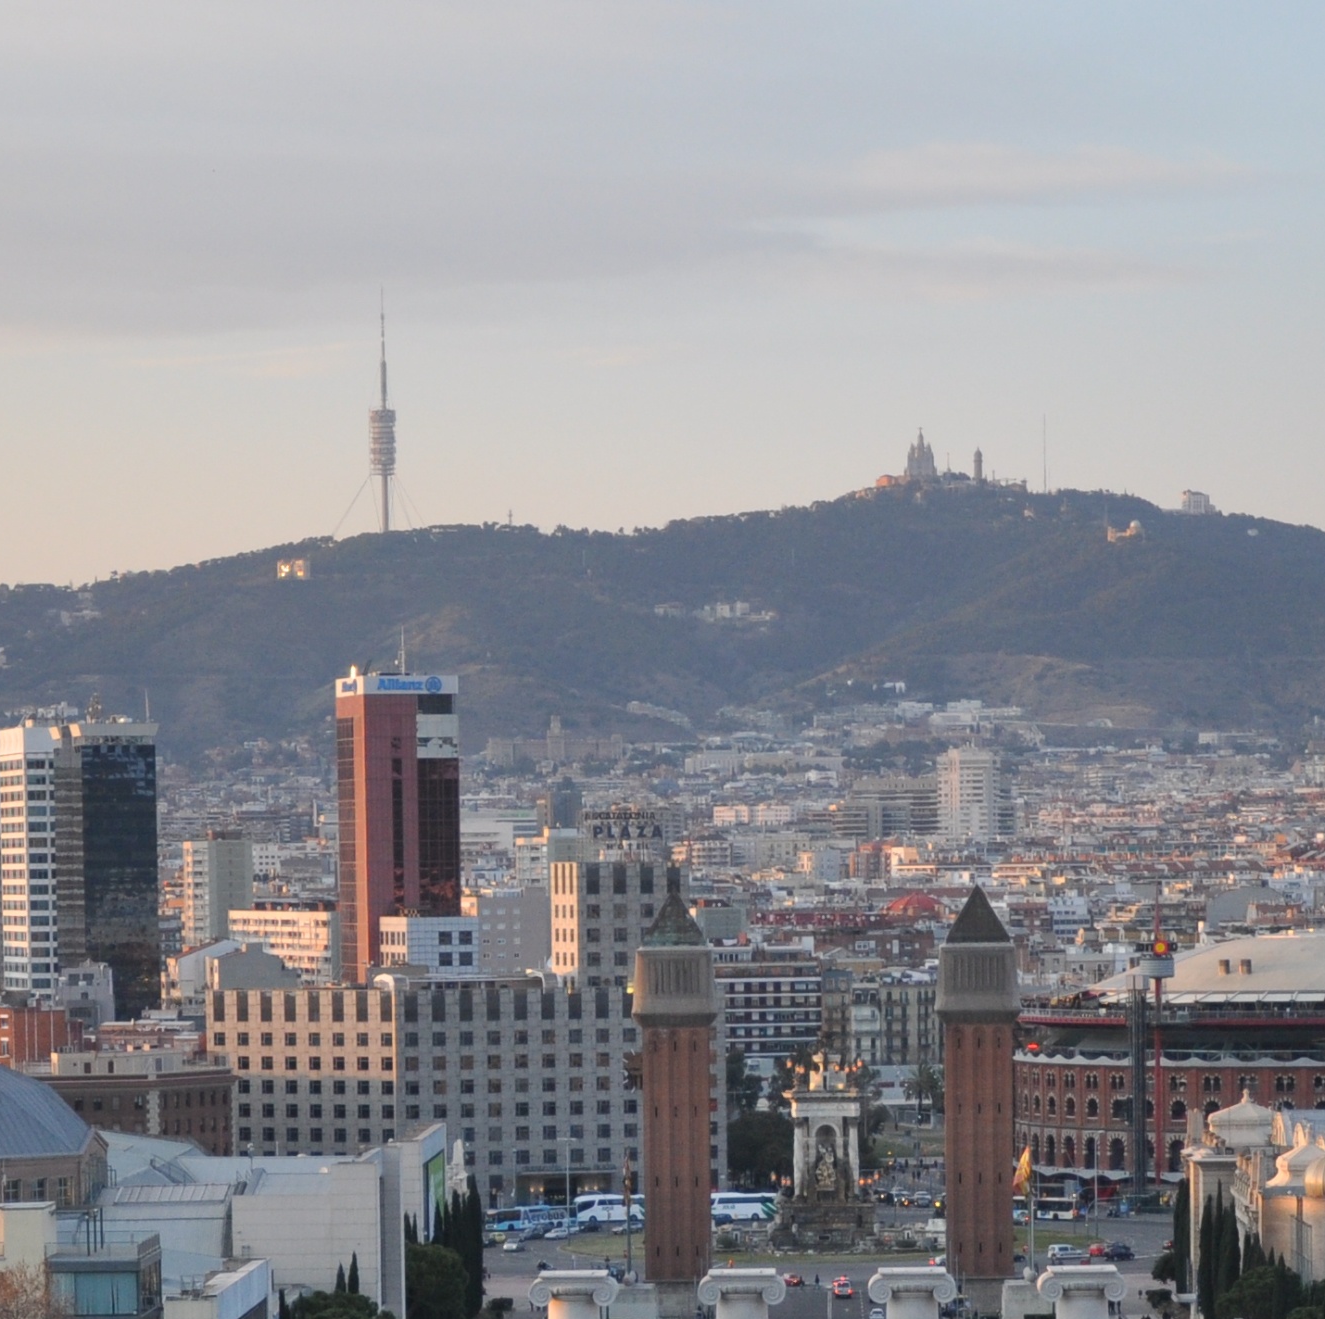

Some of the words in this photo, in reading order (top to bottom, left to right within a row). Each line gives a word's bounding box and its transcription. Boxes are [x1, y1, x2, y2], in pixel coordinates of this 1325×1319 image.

[377, 678, 423, 691] Allianz
[593, 824, 663, 839] PLAZA
[522, 1209, 566, 1225] Aerobus
